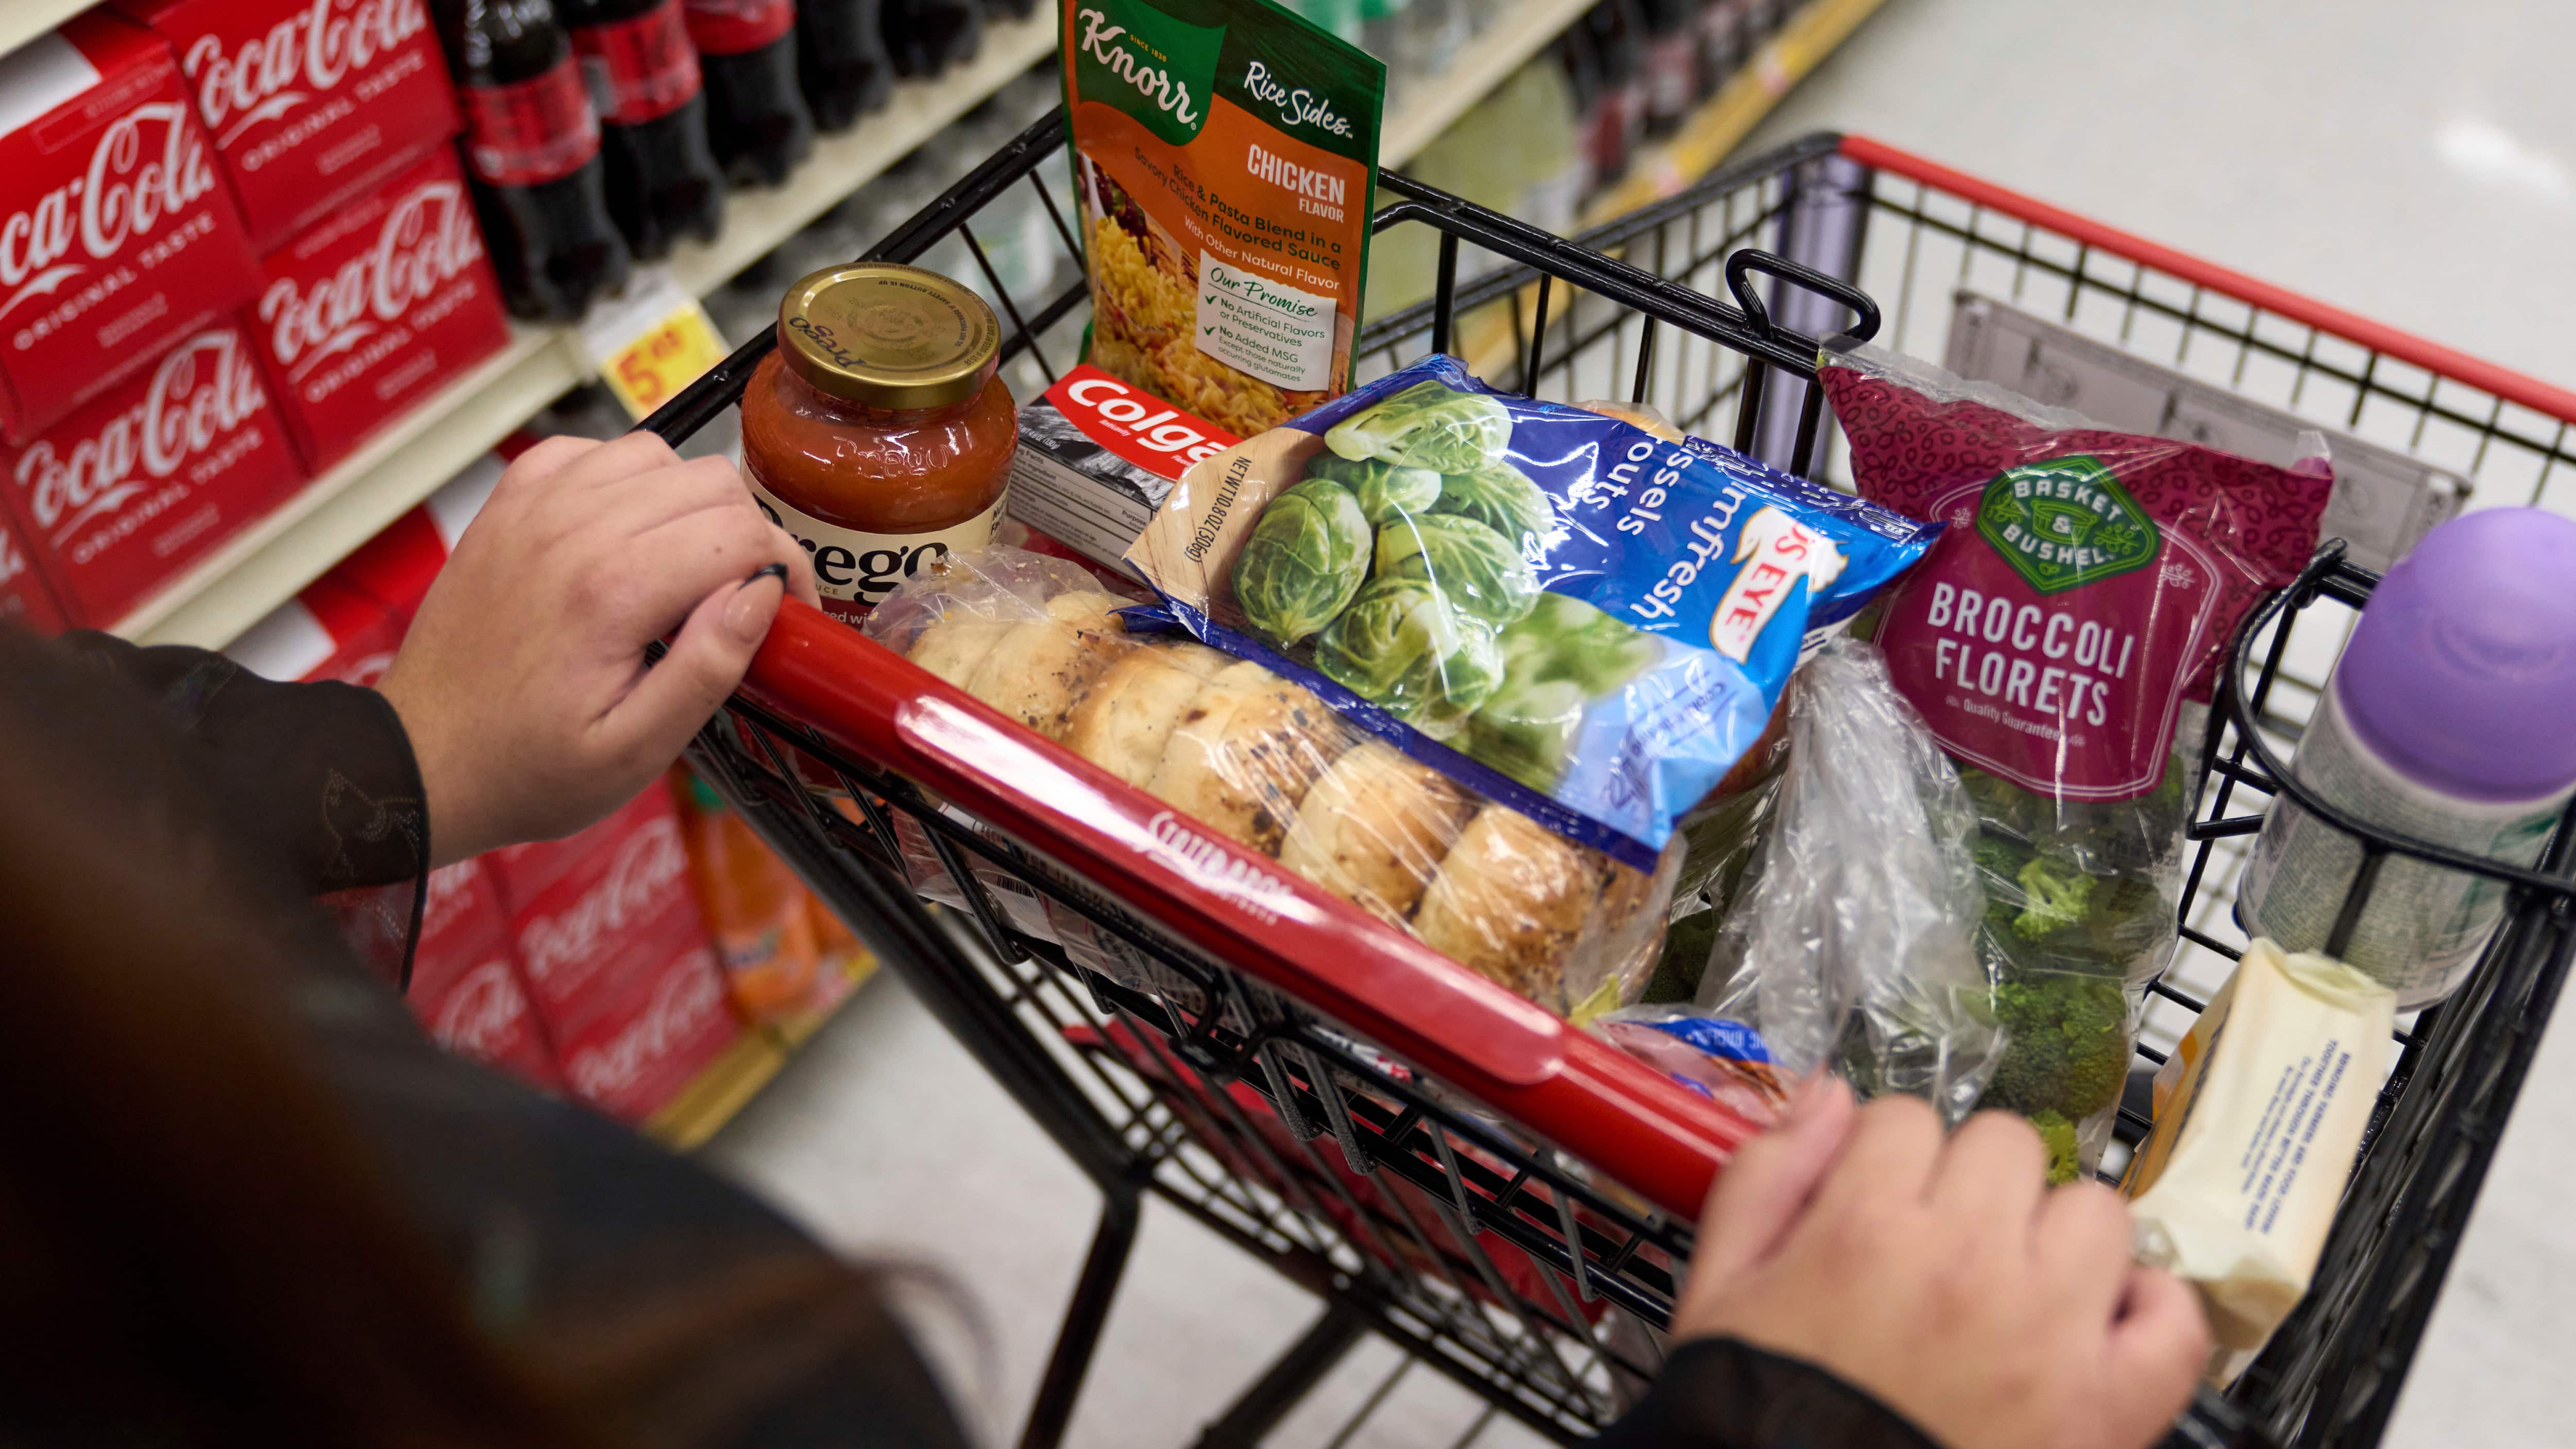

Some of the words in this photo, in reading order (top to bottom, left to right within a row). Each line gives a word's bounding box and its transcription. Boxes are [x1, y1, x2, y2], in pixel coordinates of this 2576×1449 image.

[1080, 8, 1198, 124] Knorr
[1130, 35, 1149, 52] SINCE
[1151, 48, 1167, 62] 1838
[1244, 61, 1287, 107] Rice
[1281, 89, 1350, 135] Sides
[0, 102, 214, 287] ca-Cola
[1247, 143, 1345, 206] CHICKEN
[1135, 146, 1167, 188] Savory
[1170, 178, 1208, 222] Chicken
[1212, 213, 1283, 252] Flavored
[1288, 243, 1341, 271] Sauce
[1173, 164, 1195, 192] Rice
[1197, 185, 1206, 202] &
[1210, 192, 1249, 225] Pasta
[1256, 216, 1305, 243] Blend
[1311, 232, 1326, 248] in
[1331, 242, 1341, 254] a
[1299, 198, 1344, 224] FLAVOR
[1185, 214, 1204, 240] With
[1206, 234, 1239, 258] Other
[1242, 251, 1293, 277] Natural
[1296, 268, 1340, 290] Flavor
[900, 281, 928, 293] BUTTON
[1211, 267, 1241, 290] Our
[1243, 281, 1318, 317] Promise
[1220, 311, 1229, 320] or
[1232, 315, 1302, 347] Preservatives
[1221, 298, 1234, 311] No
[1236, 306, 1281, 329] Artificial
[1283, 323, 1326, 339] Flavors
[789, 316, 869, 369] Prego
[1219, 325, 1233, 339] No
[1235, 334, 1269, 355] Added
[1272, 347, 1299, 363] MSG
[1219, 336, 1244, 355] Except
[1245, 349, 1267, 363] those
[1268, 358, 1306, 375] naturally
[1218, 346, 1252, 367] occurring
[1253, 362, 1301, 382] glutamates
[1067, 379, 1229, 462] Colga
[1098, 419, 1132, 436] Anticavity
[1222, 476, 1241, 497] WT
[1230, 456, 1252, 479] NET
[1211, 493, 1234, 517] 10.8
[1616, 448, 1694, 536] ssels
[2013, 479, 2123, 521] BASKET
[1204, 514, 1224, 531] OZ
[2052, 515, 2071, 534] &
[1184, 527, 1216, 563] (306g)
[1630, 483, 1748, 619] mfresh
[2002, 524, 2106, 566] BUSHEL
[1725, 562, 1788, 632] EYE
[1927, 581, 2136, 679] BROCCOLI
[1935, 637, 2110, 727] FLORETS
[1963, 698, 2002, 723] Quality
[2002, 712, 2063, 743] Guarantee
